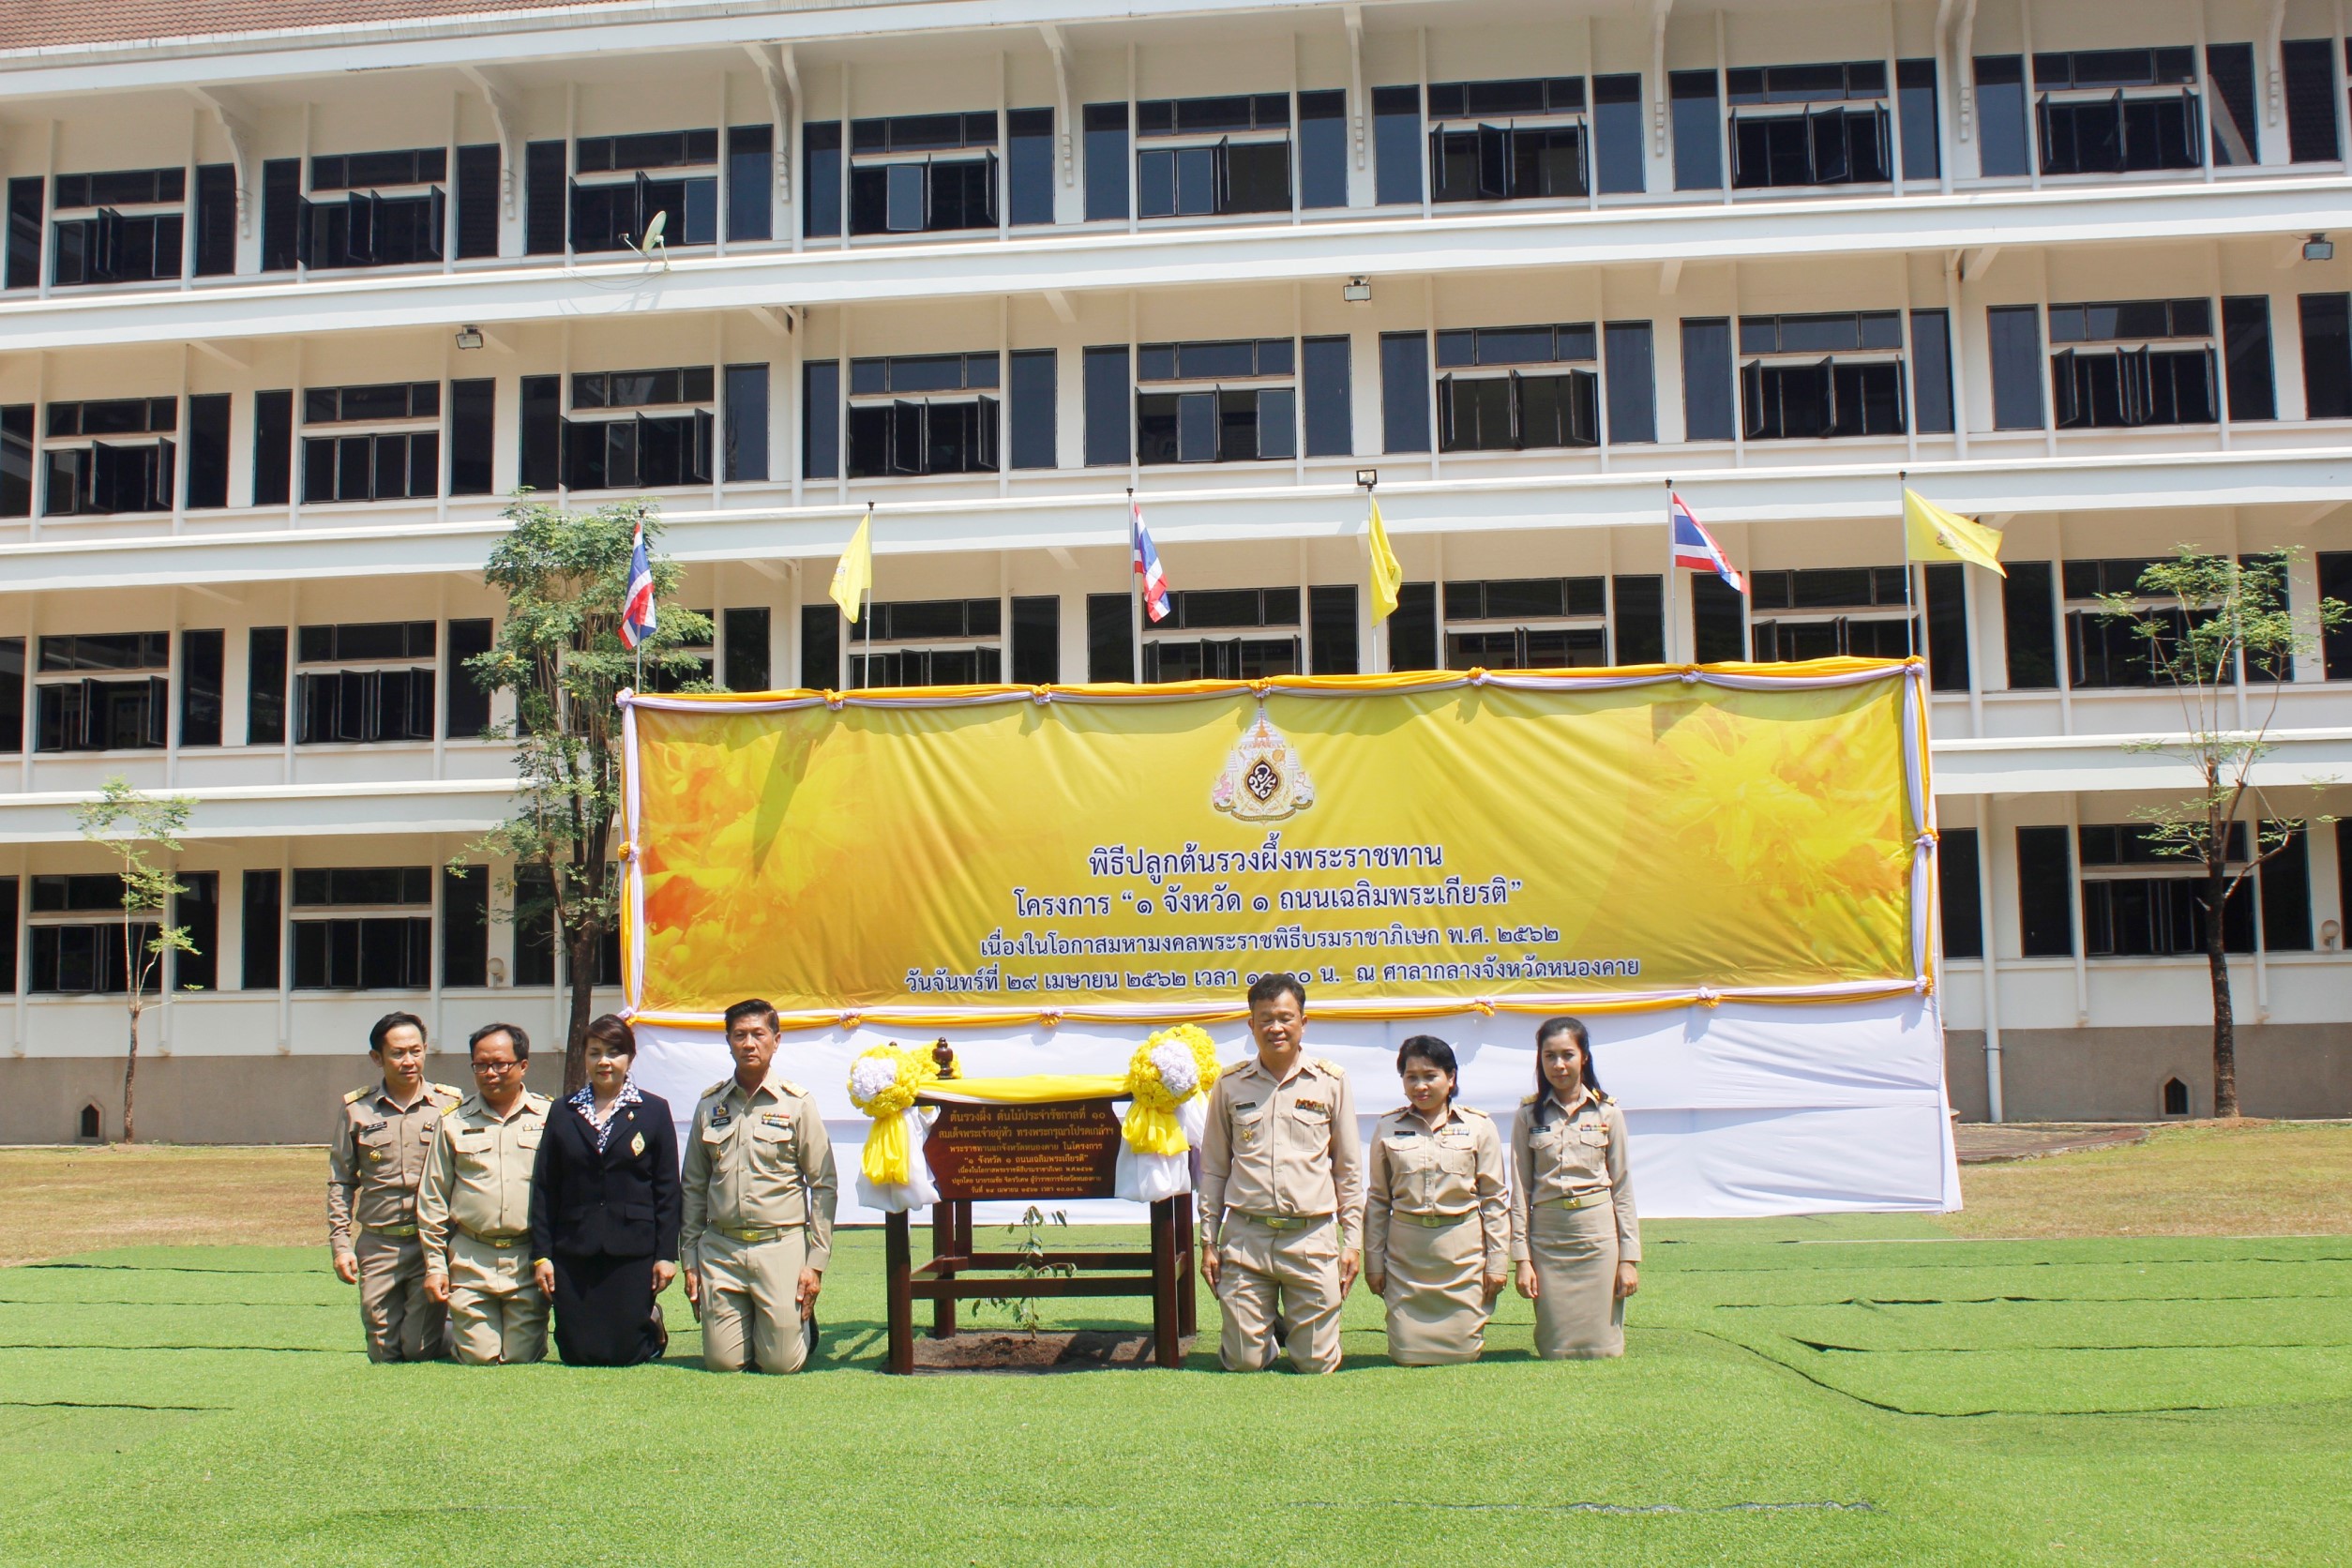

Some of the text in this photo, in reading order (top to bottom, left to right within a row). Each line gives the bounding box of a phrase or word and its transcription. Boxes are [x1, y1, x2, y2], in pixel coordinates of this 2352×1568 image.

[1089, 832, 1442, 884] พิธีปลูกต้นรวงผึ้งพระราชทาน
[1013, 888, 1109, 917] โครงการ
[1163, 884, 1241, 913] จังหวัด
[1253, 894, 1269, 912] ๑
[980, 923, 1560, 957] เนื่องในโอกาสมหามงคลพระราชพิธีบรมราชาภิเษก พ.ศ. ๒๕๖๒
[905, 964, 999, 993] วันจันทร์ที่
[1006, 973, 1036, 990] ๒๙
[1044, 972, 1118, 990] เมษายน
[1126, 970, 1186, 988] ๒๕๖๒
[1195, 968, 1237, 987] เวลา
[1320, 966, 1340, 983] น.
[1357, 964, 1375, 982] ณ
[1383, 954, 1639, 982] ศาลากลางจังหวัดหนองคาย
